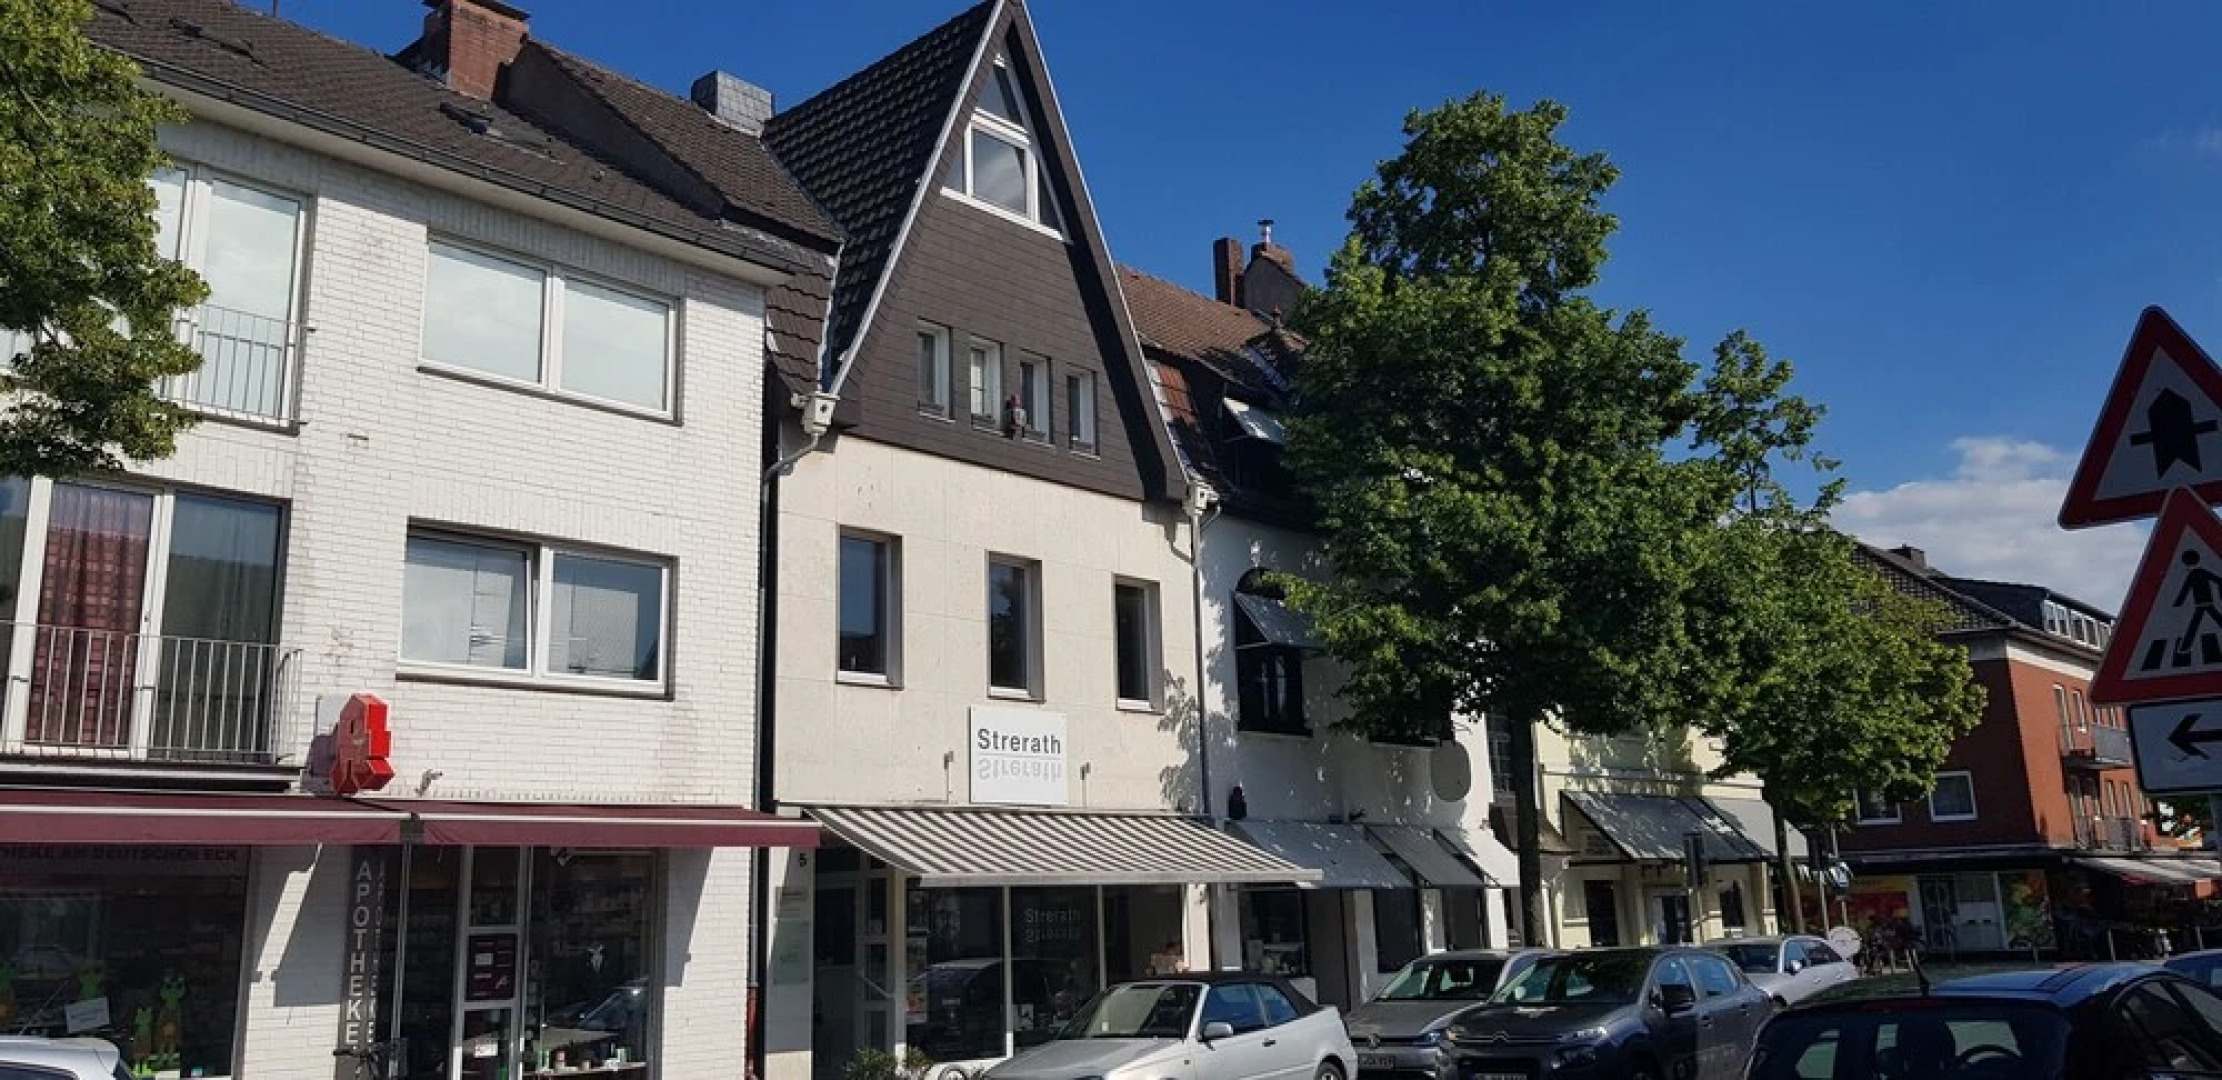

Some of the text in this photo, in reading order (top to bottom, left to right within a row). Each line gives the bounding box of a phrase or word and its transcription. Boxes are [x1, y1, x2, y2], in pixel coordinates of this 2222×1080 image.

[978, 728, 1061, 754] Strerath
[202, 848, 238, 861] ECK
[799, 853, 808, 867] 5
[346, 859, 372, 1046] APOTHEKE
